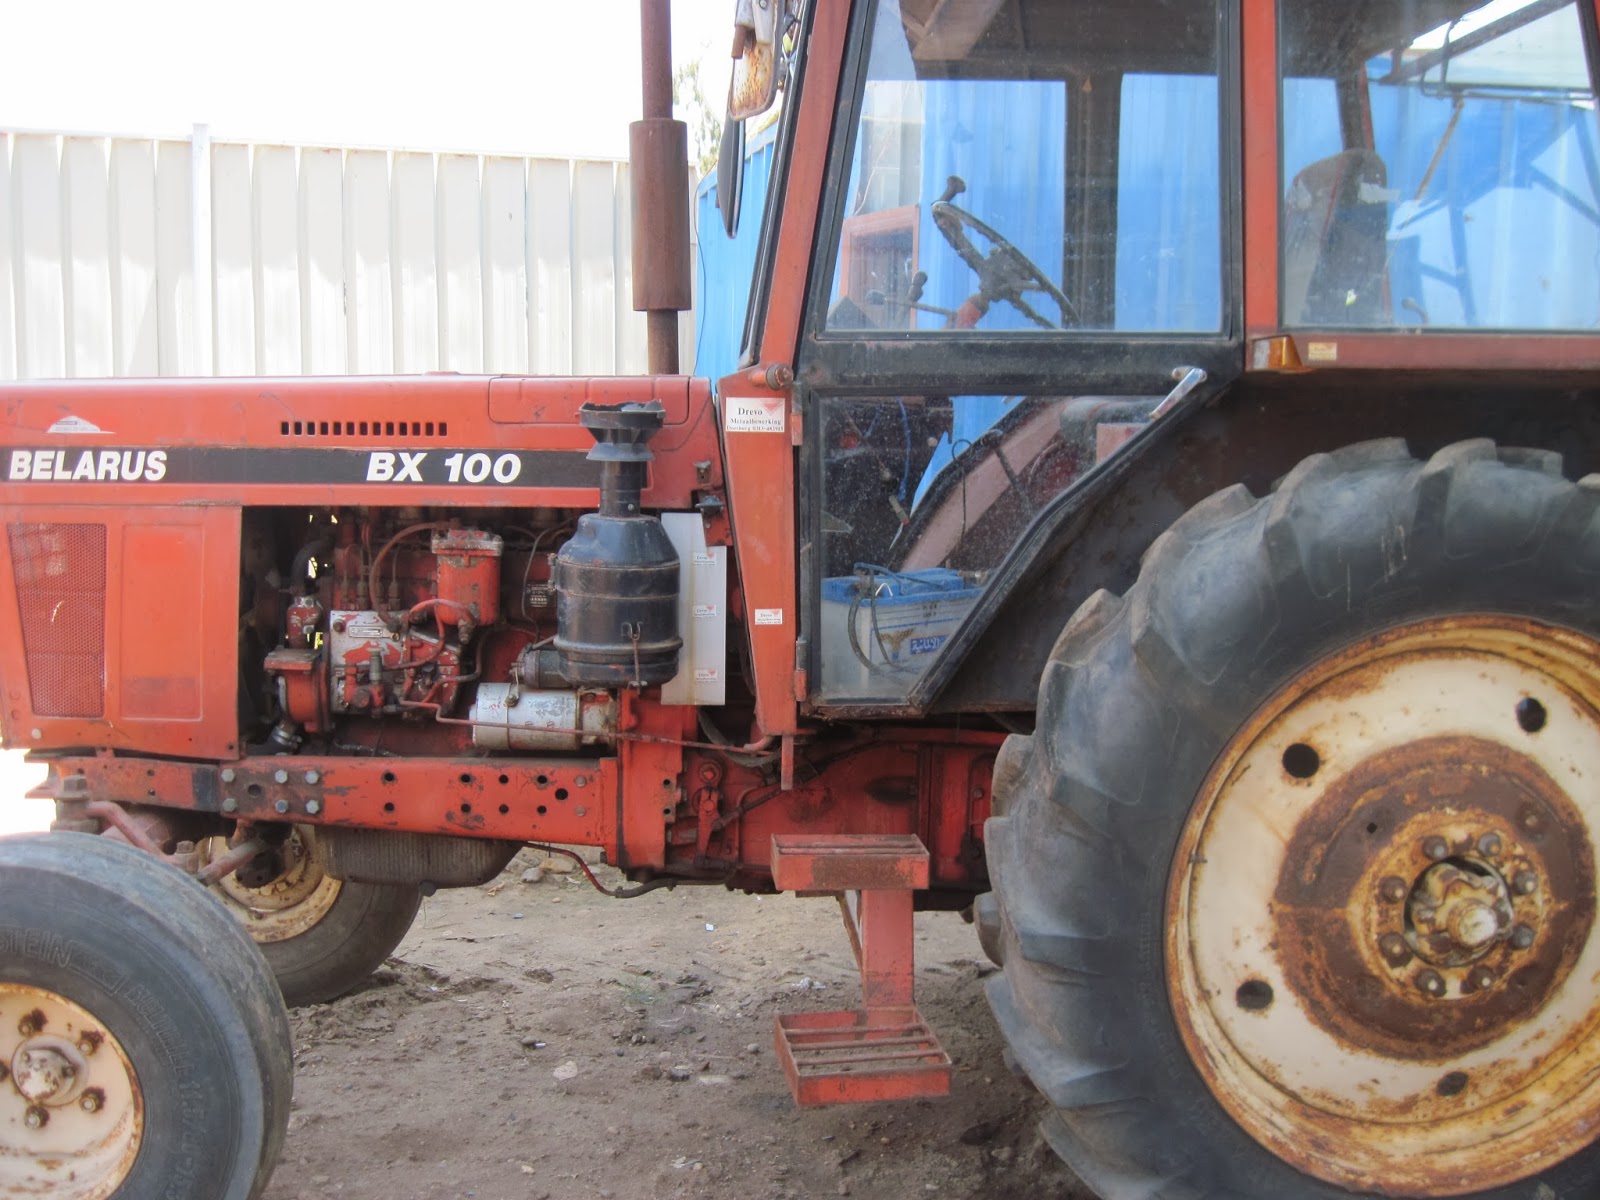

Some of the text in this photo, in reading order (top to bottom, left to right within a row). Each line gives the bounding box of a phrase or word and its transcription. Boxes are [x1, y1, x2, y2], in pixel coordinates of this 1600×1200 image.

[737, 407, 763, 416] Drevo
[9, 450, 168, 481] BELARUS
[366, 452, 522, 484] BX 100
